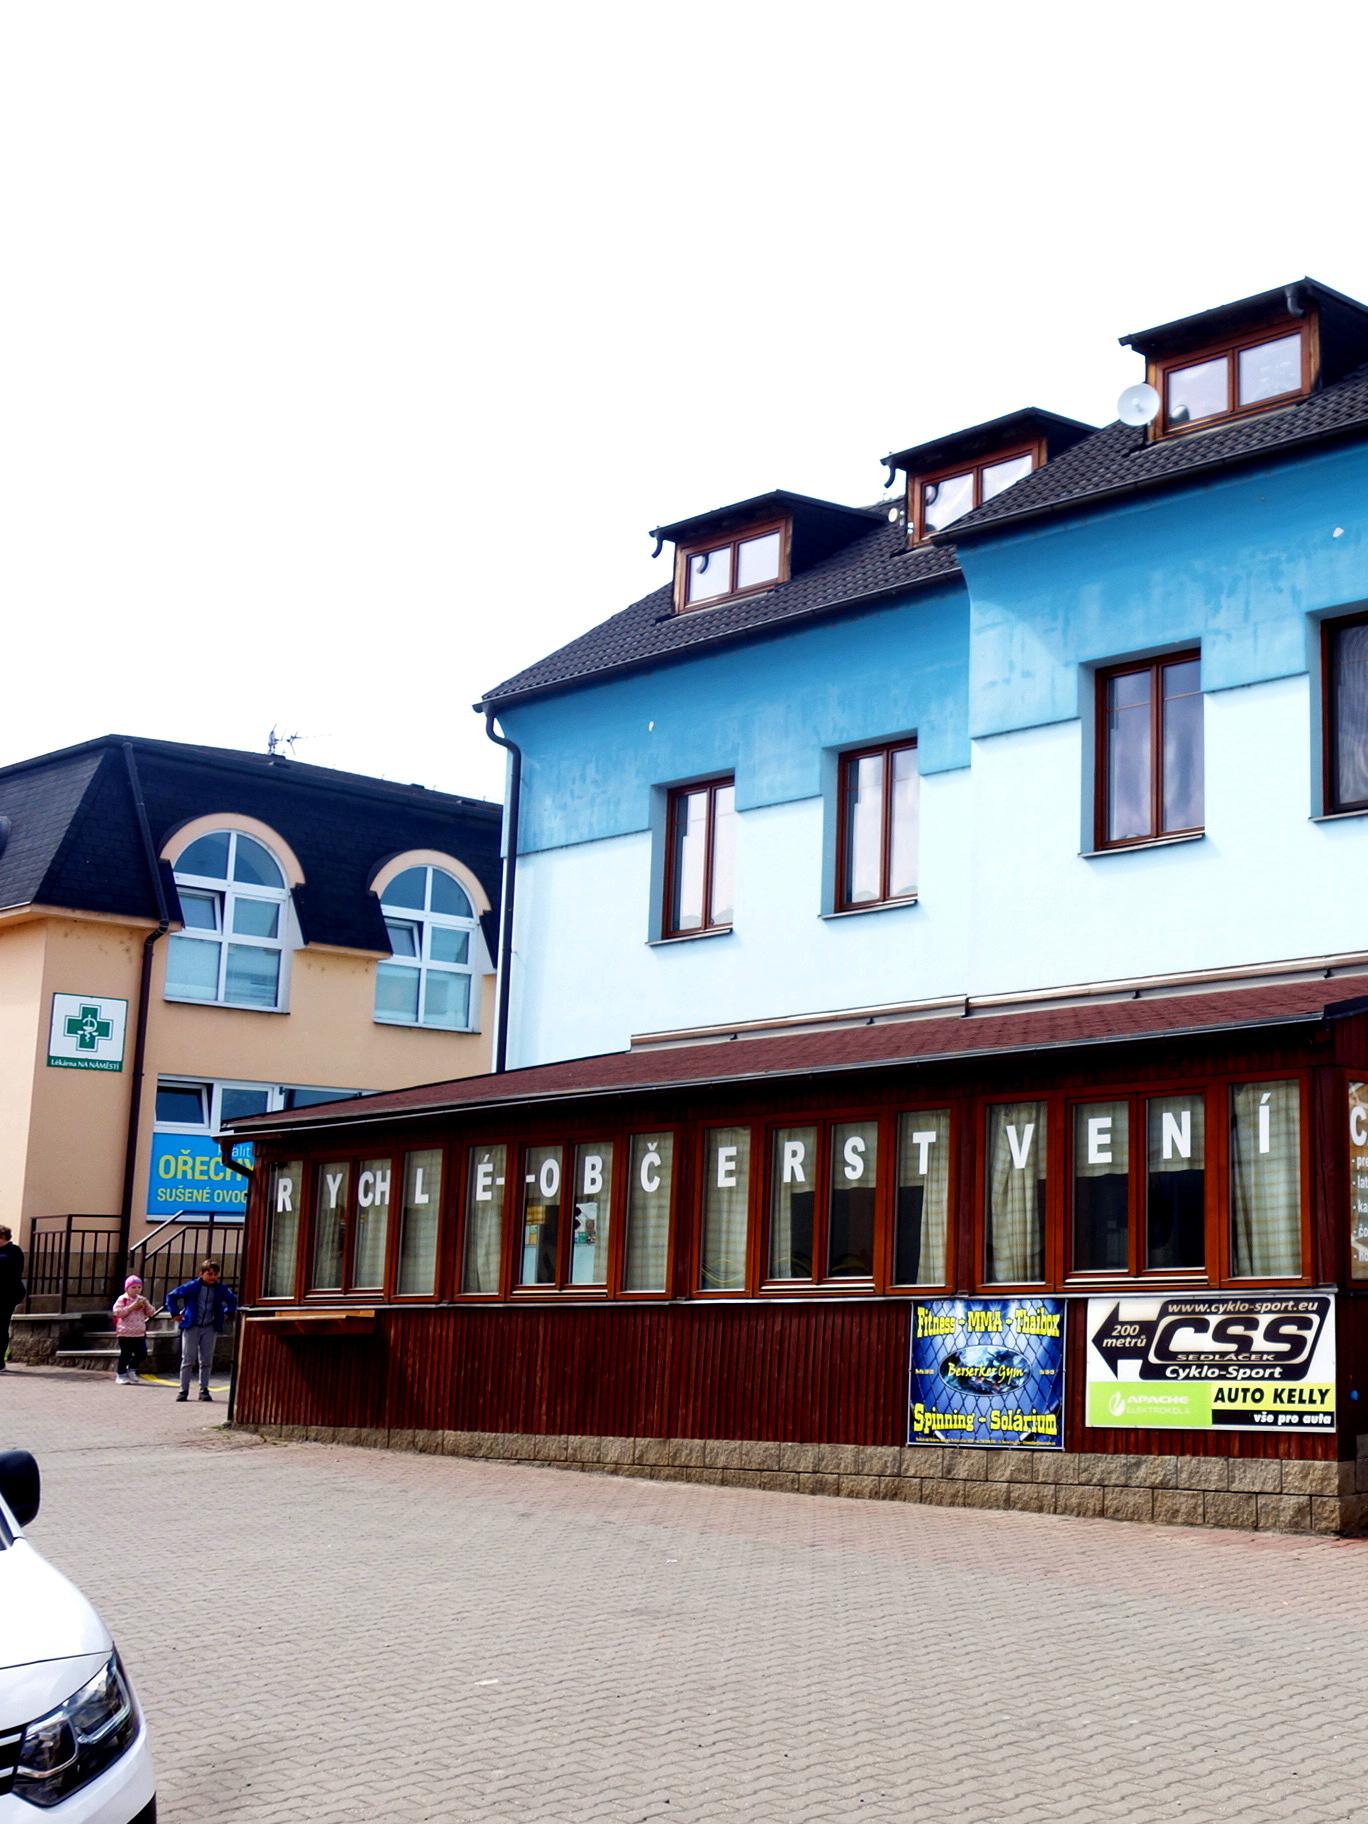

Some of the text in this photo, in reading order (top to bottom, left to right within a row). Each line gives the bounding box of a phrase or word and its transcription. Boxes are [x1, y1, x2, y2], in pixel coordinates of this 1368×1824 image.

[51, 1058, 77, 1067] Lékárna
[89, 1060, 119, 1070] NÁMĚSTÍ
[157, 1185, 211, 1202] SUŠENÉ
[1168, 1300, 1318, 1314] www.cyklo-sport.eu
[917, 1306, 956, 1338] Fitness
[967, 1311, 1002, 1333] MMA
[1015, 1307, 1060, 1337] Thaibox
[1112, 1325, 1140, 1336] 200
[1102, 1336, 1146, 1348] metrů
[1154, 1316, 1314, 1361] CSS
[1176, 1353, 1276, 1362] SEDLÁČEK
[998, 1364, 1025, 1384] Gym
[1165, 1365, 1283, 1380] Cyklo-Sport
[1127, 1395, 1190, 1405] APACHE
[1213, 1387, 1331, 1405] AUTO KELLY
[913, 1403, 975, 1435] Spinning
[990, 1409, 1058, 1436] Solárium
[1253, 1411, 1332, 1426] vše pro auta
